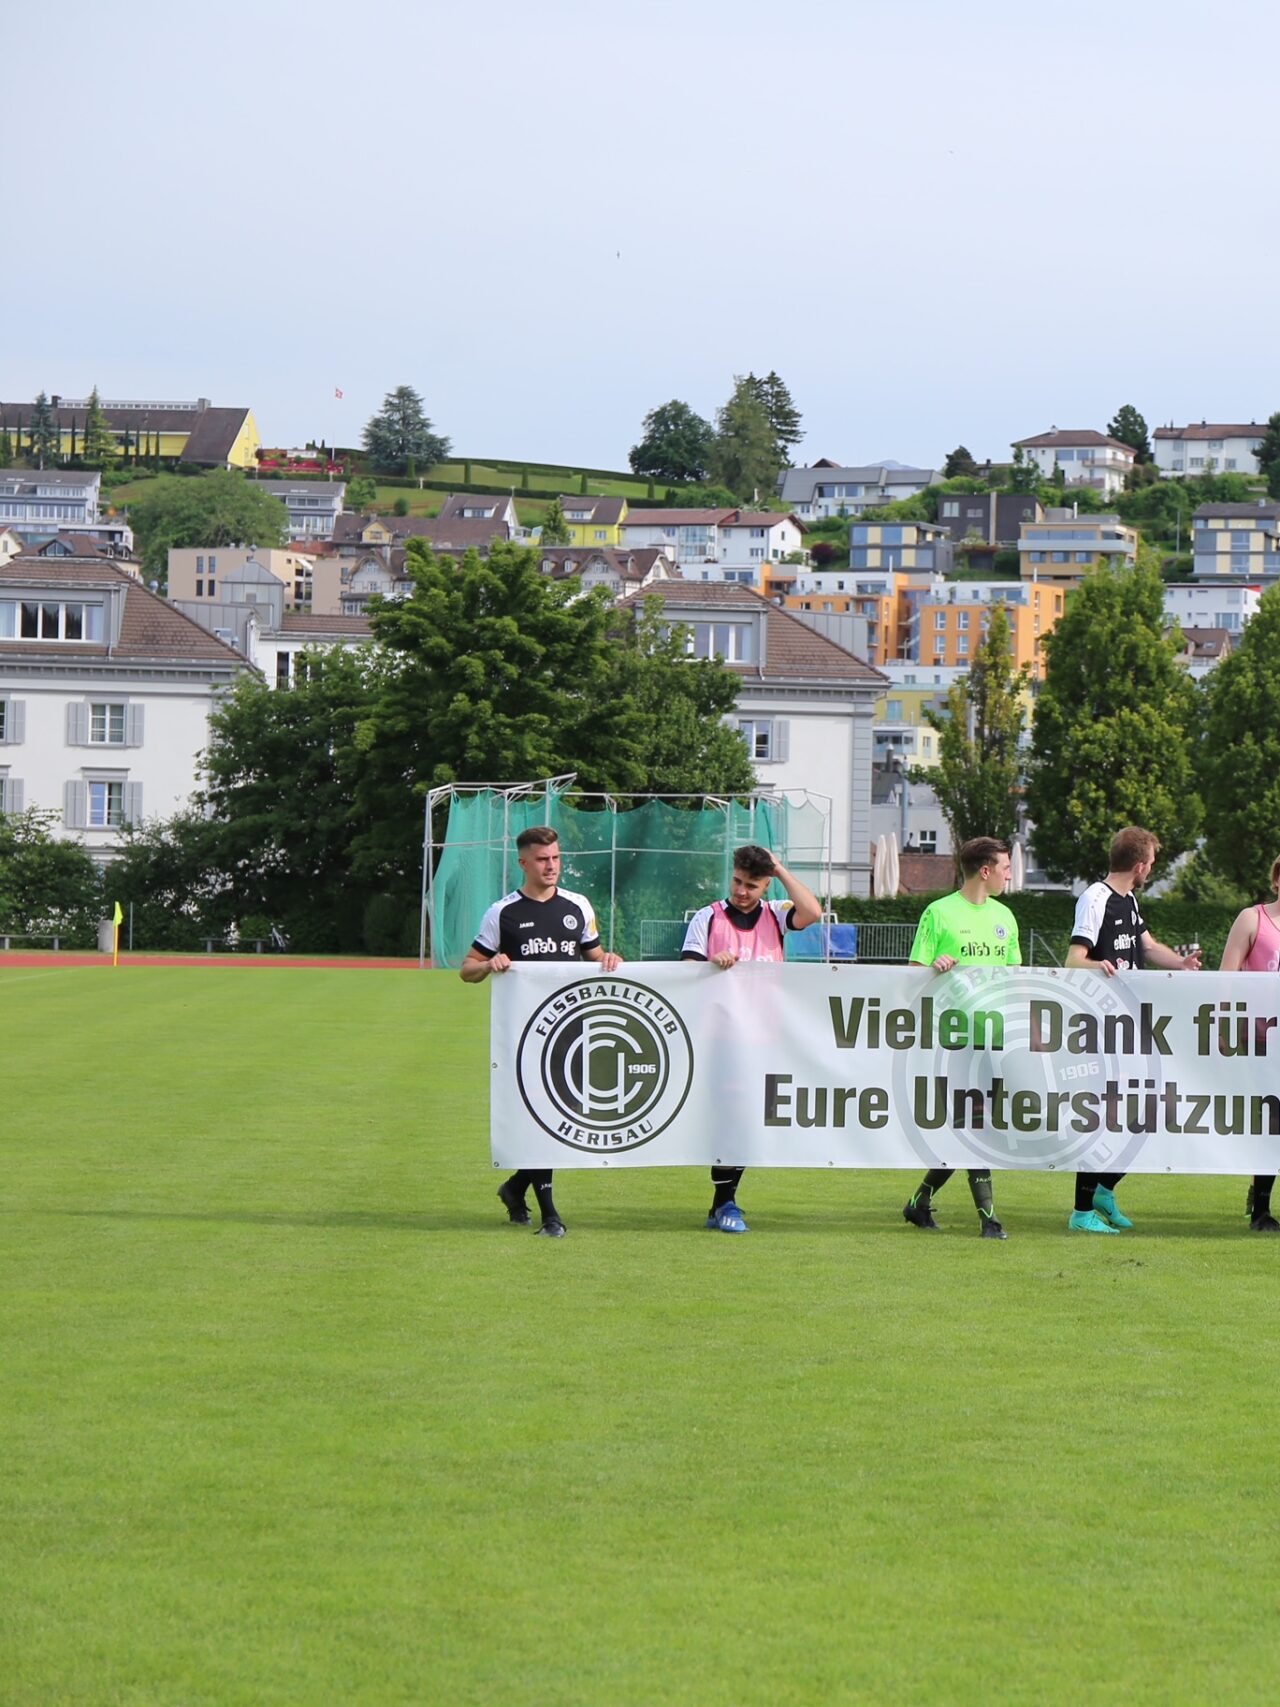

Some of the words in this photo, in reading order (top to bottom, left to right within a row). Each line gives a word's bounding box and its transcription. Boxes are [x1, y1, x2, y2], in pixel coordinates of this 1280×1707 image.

[520, 936, 557, 955] elfab
[560, 940, 576, 956] ag
[535, 984, 678, 1038] FUSSBALLCLUB
[828, 995, 1005, 1052] Vielen
[1029, 999, 1174, 1056] Dank
[1192, 1001, 1278, 1058] für
[627, 1064, 657, 1075] 1906
[1059, 1061, 1100, 1081] 1906
[764, 1073, 889, 1130] Eure
[557, 1119, 654, 1147] HERISAU
